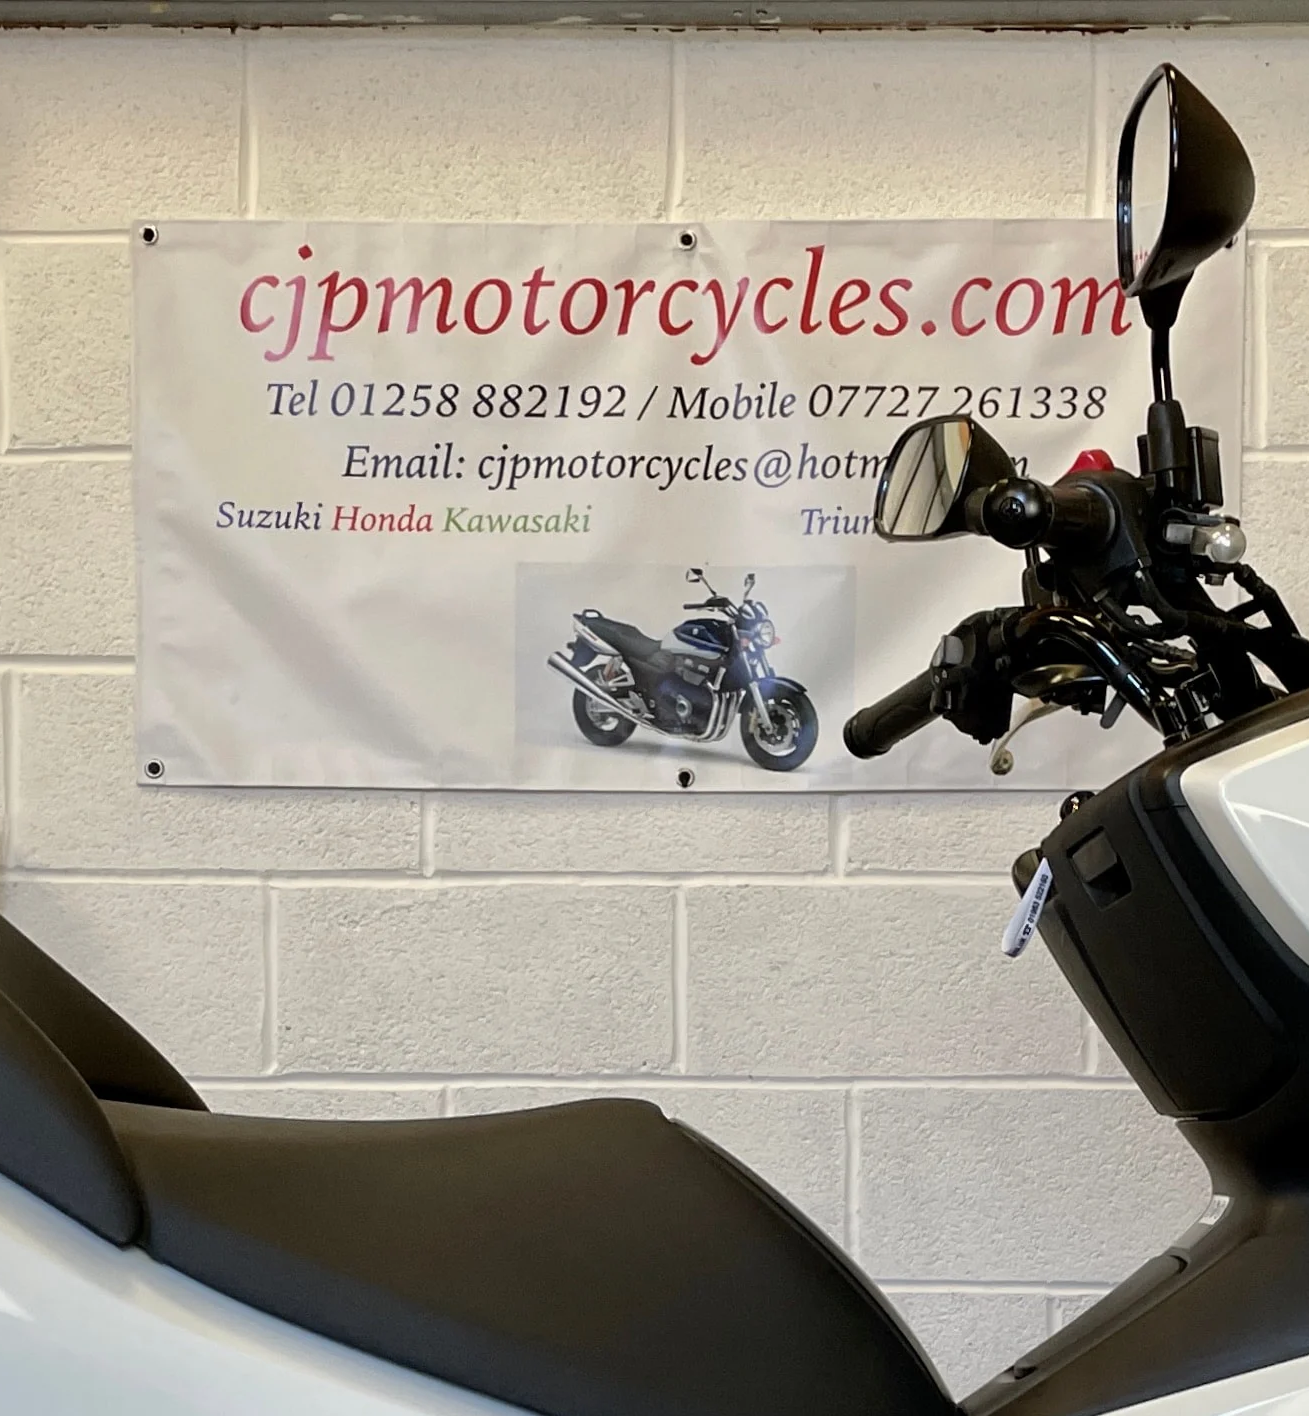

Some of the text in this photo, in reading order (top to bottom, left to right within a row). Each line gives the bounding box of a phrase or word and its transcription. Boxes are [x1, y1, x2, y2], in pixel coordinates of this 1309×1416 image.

[239, 244, 1132, 366] cjpmotorcycles.com
[267, 380, 1108, 421] Tel 01258 882192 / Mobile 07727 261338
[342, 442, 465, 479] Email:
[216, 501, 592, 536] Suzuki Honda Kawasaki
